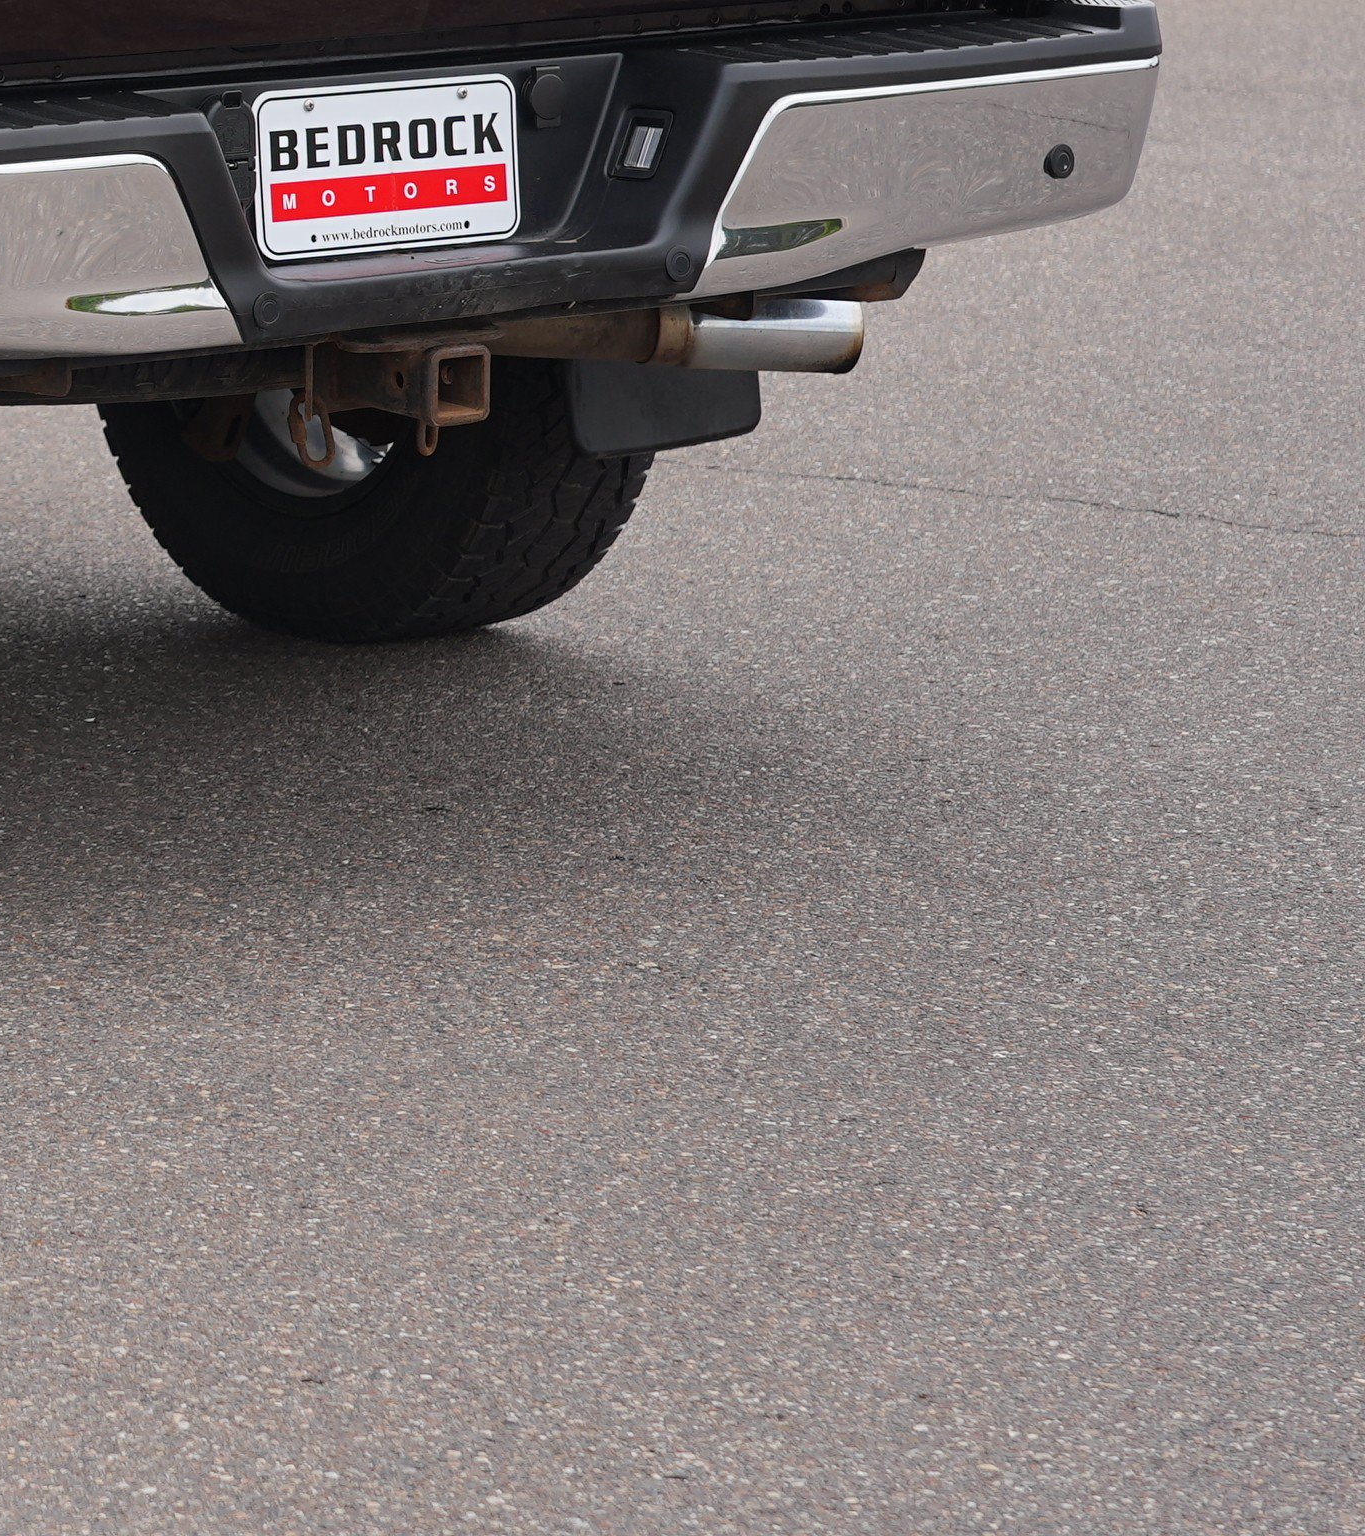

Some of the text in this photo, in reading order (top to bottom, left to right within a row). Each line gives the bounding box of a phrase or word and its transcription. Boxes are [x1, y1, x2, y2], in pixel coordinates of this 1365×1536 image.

[269, 112, 504, 172] BEDROCK
[282, 175, 497, 211] MOTORS
[321, 220, 463, 243] www.bedrockmotors.com
